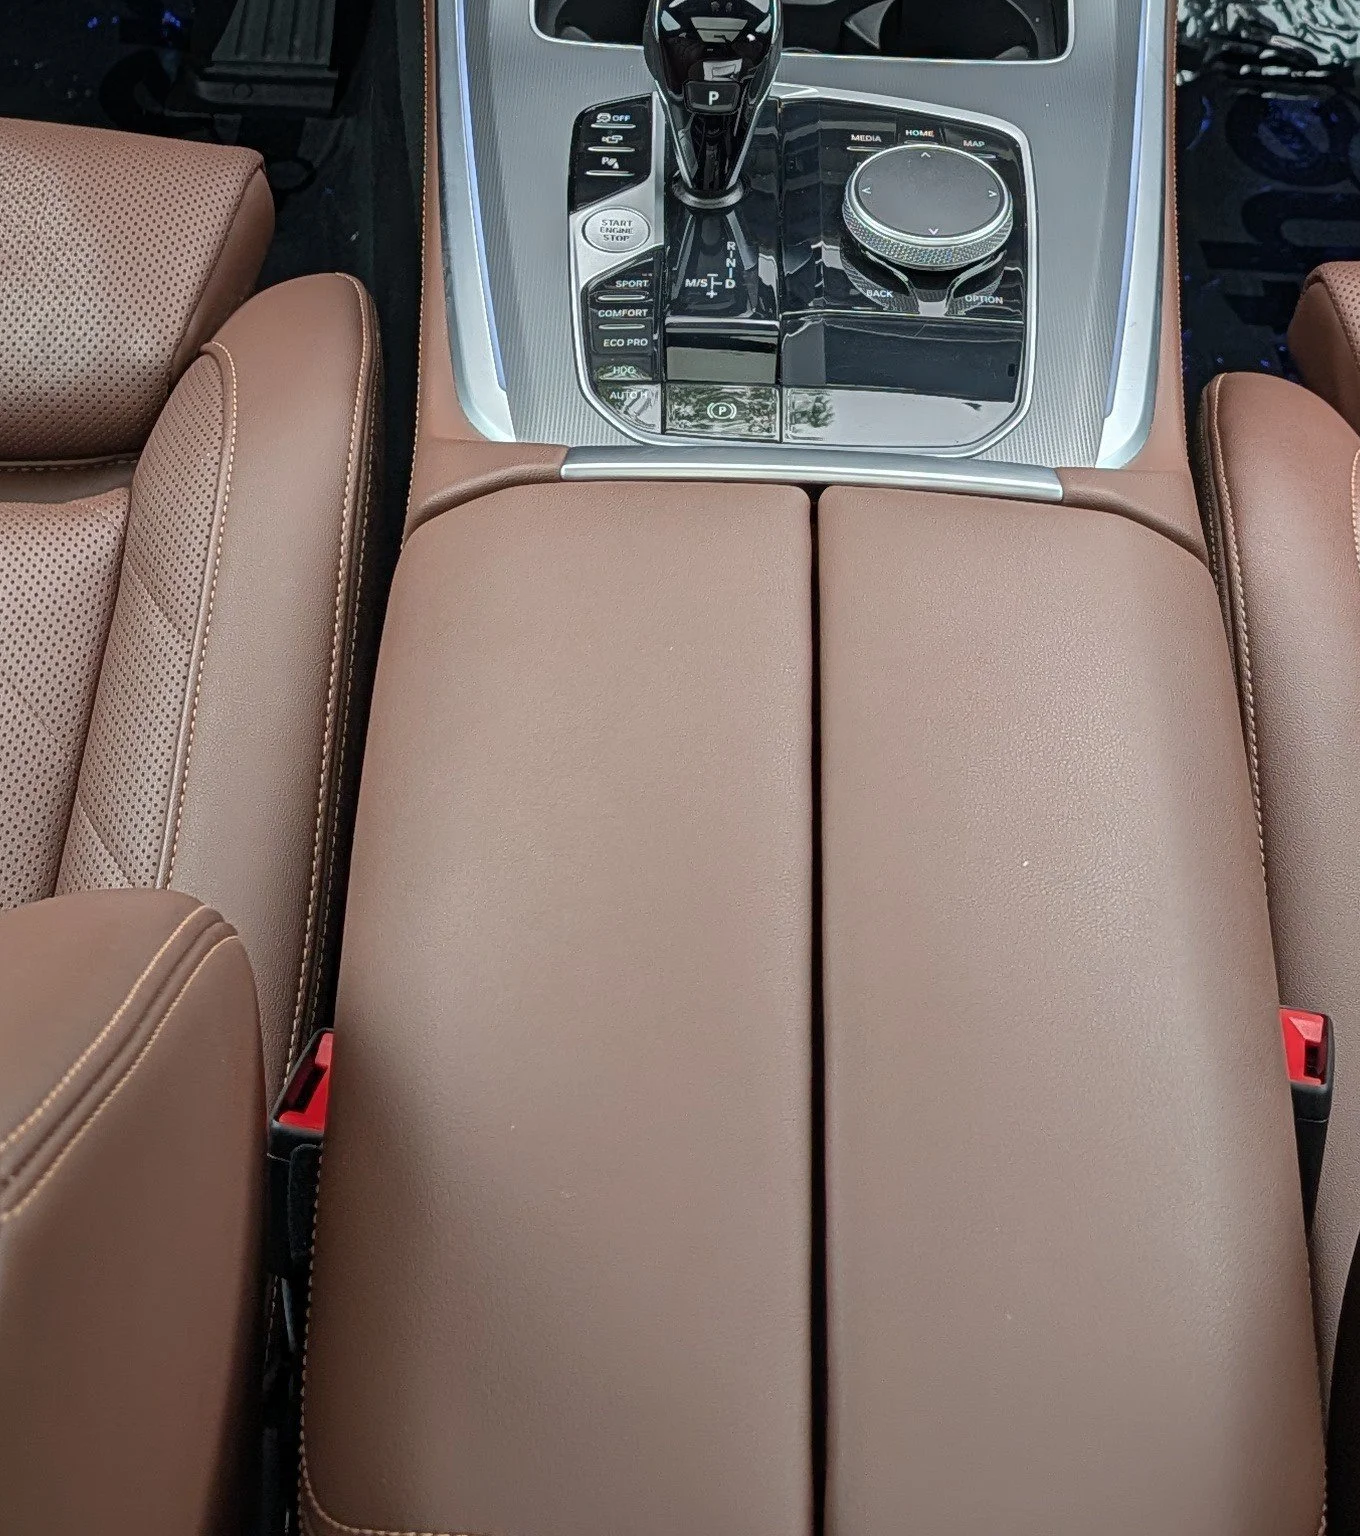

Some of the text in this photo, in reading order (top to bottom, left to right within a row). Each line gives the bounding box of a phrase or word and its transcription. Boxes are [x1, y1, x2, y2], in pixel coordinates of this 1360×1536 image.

[708, 90, 720, 106] P
[612, 114, 631, 123] OFF
[850, 133, 882, 143] MEDIA
[905, 129, 935, 138] HOME
[963, 139, 985, 148] MAP
[601, 219, 633, 228] START
[599, 227, 634, 235] ENGINE
[603, 235, 630, 243] STOP
[727, 241, 736, 251] R
[726, 258, 736, 268] N
[615, 279, 650, 289] SPORT
[685, 278, 708, 288] M/S
[725, 279, 736, 289] D
[866, 289, 894, 299] BACK
[965, 294, 1004, 305] OPTION
[598, 308, 649, 318] COMFORT
[603, 338, 649, 348] ECO PRO
[609, 390, 638, 400] AUTO
